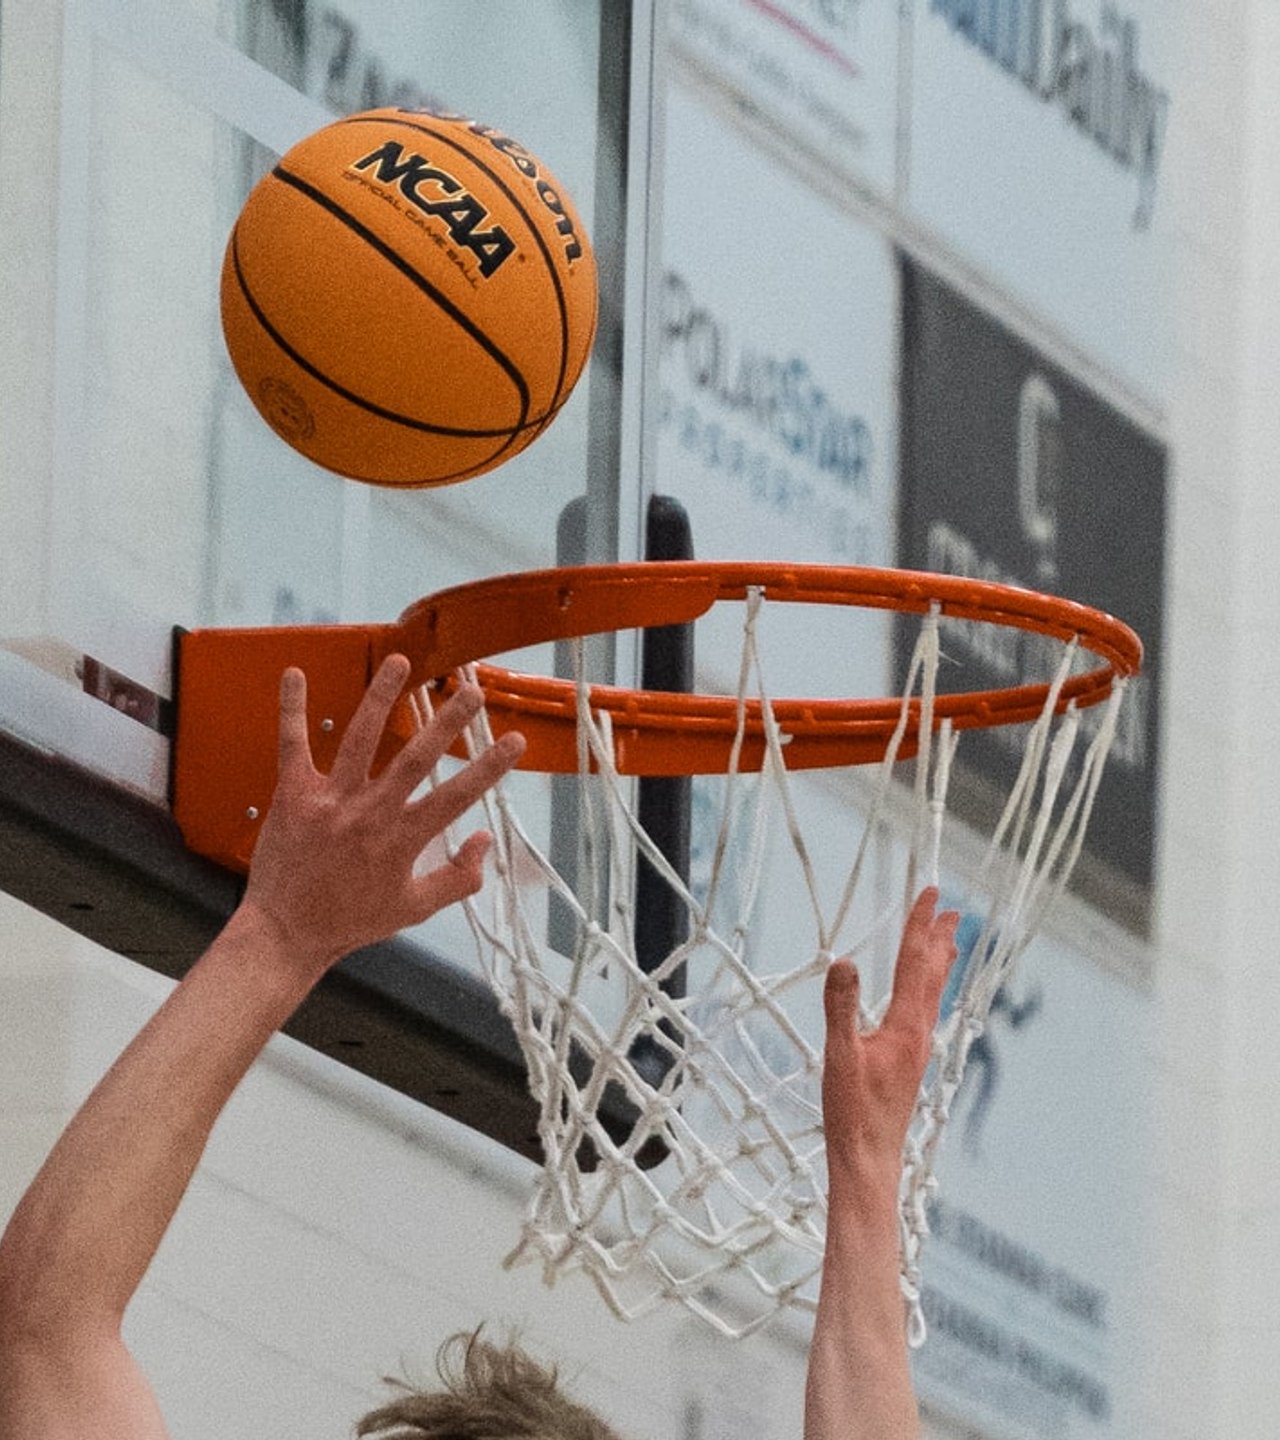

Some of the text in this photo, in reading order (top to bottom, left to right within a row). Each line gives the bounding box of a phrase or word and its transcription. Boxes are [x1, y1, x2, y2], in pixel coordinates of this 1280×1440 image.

[352, 140, 517, 279] NCAA
[405, 209, 448, 249] GAME
[446, 248, 478, 290] BALL
